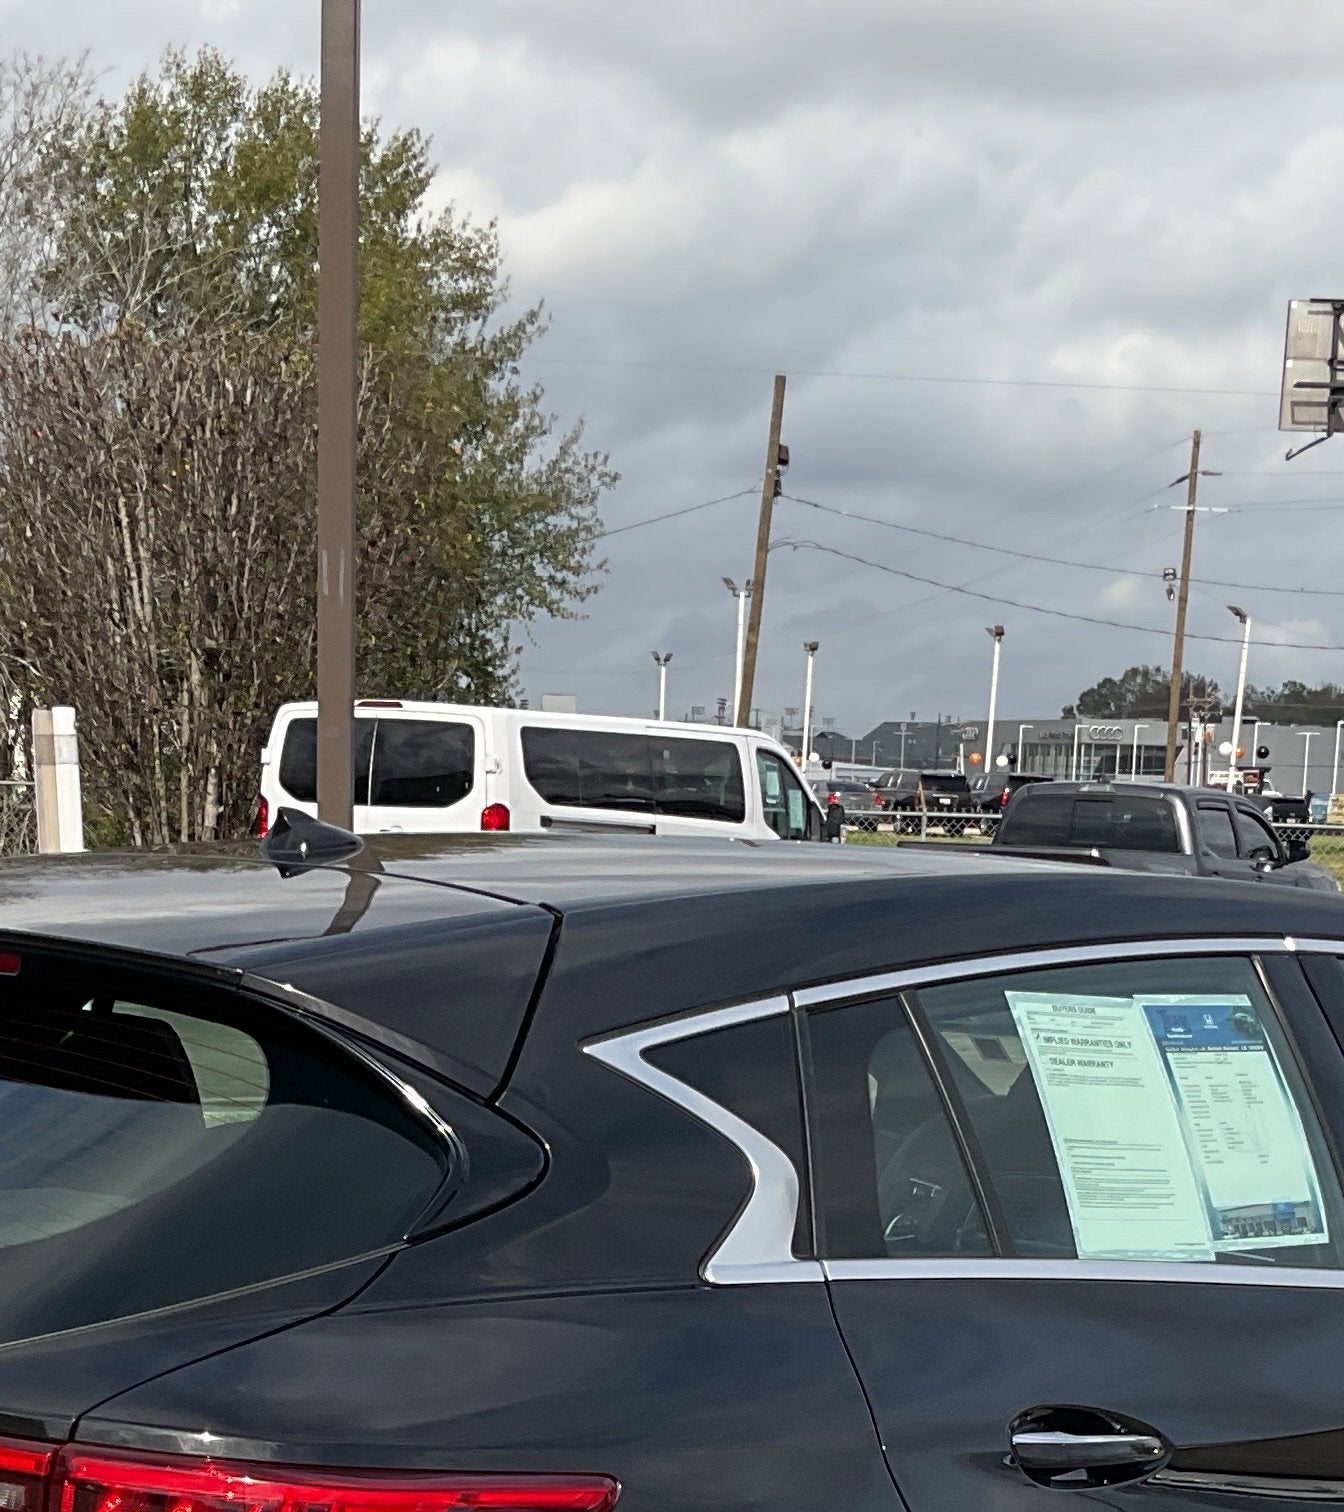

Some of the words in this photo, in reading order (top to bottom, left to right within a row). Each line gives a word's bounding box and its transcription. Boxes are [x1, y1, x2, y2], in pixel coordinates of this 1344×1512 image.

[1043, 1036, 1070, 1046] IMPLIED
[1070, 1038, 1114, 1048] WARRANTIES
[1114, 1040, 1133, 1049] ONLY
[1049, 1057, 1077, 1067] DEALER
[1077, 1059, 1115, 1069] WARRANTY
